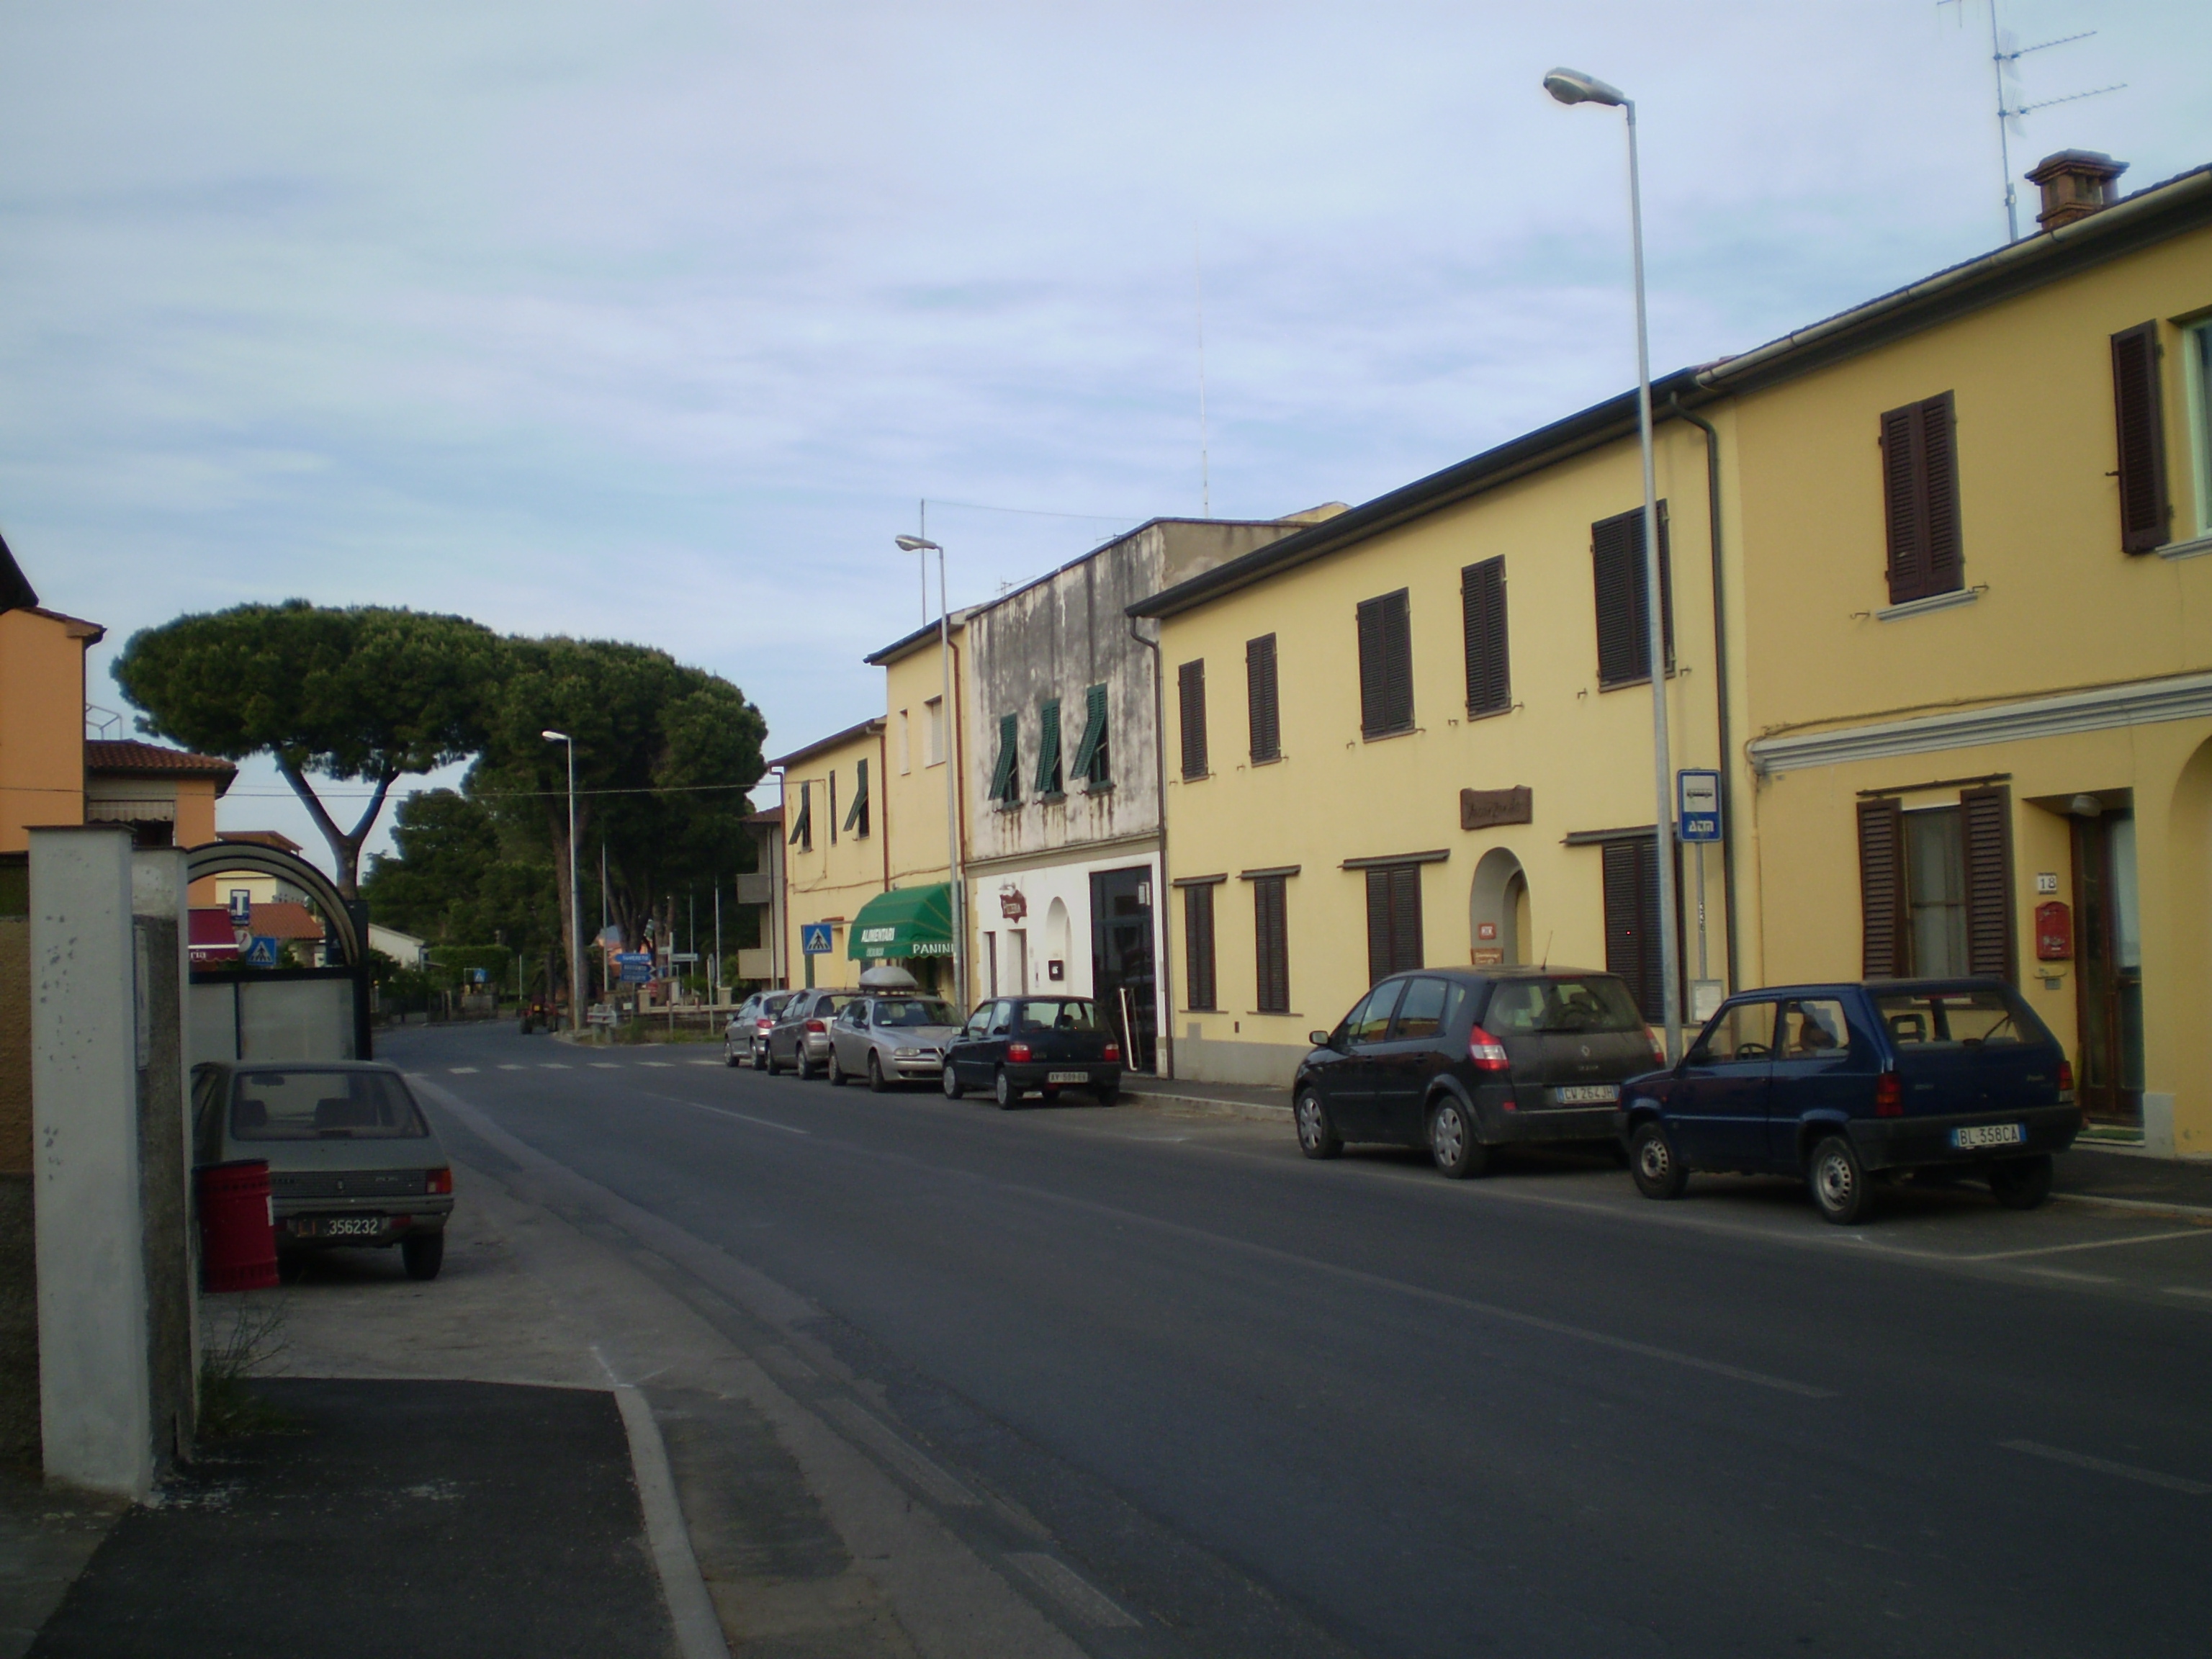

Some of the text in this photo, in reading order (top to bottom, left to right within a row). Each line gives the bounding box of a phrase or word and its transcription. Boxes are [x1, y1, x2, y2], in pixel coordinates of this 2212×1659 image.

[2040, 878, 2056, 890] 18
[861, 927, 895, 943] ALIMENTARI
[912, 943, 954, 954] PANINI
[1960, 1130, 1976, 1145] BL
[328, 1219, 378, 1235] 356232
